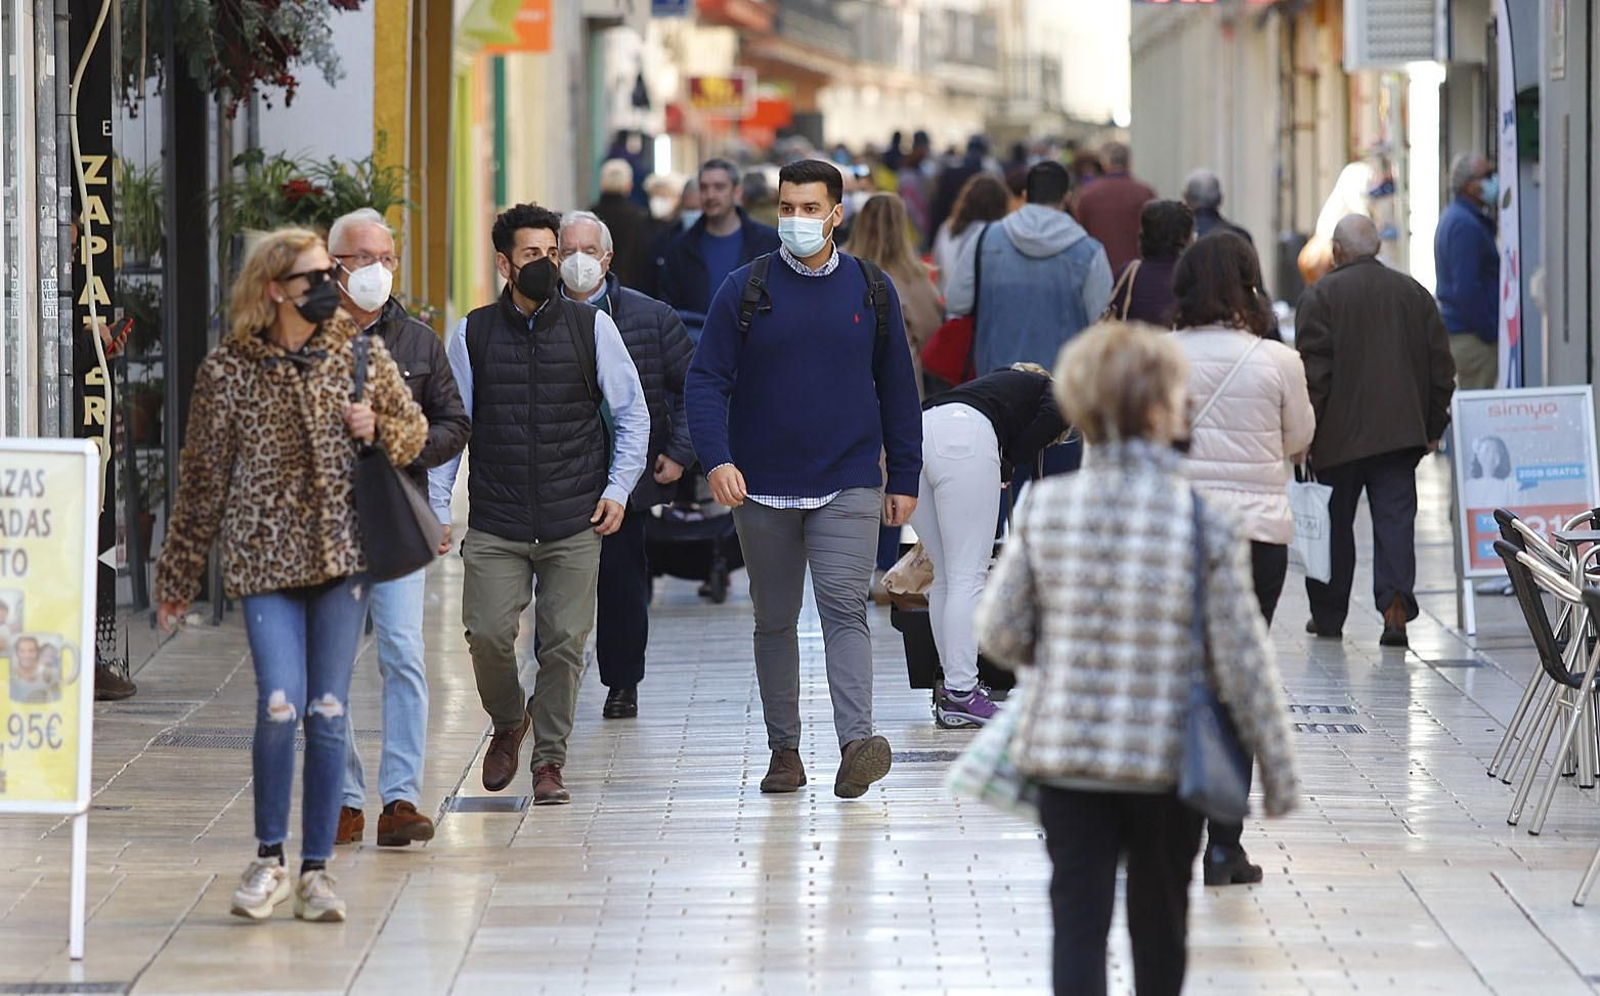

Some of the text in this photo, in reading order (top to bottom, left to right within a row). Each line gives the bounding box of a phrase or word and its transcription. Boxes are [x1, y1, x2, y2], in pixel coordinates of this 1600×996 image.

[43, 280, 50, 290] SE
[1488, 402, 1557, 419] simyo
[1546, 466, 1580, 477] GRATIS
[0, 469, 45, 498] ZAS
